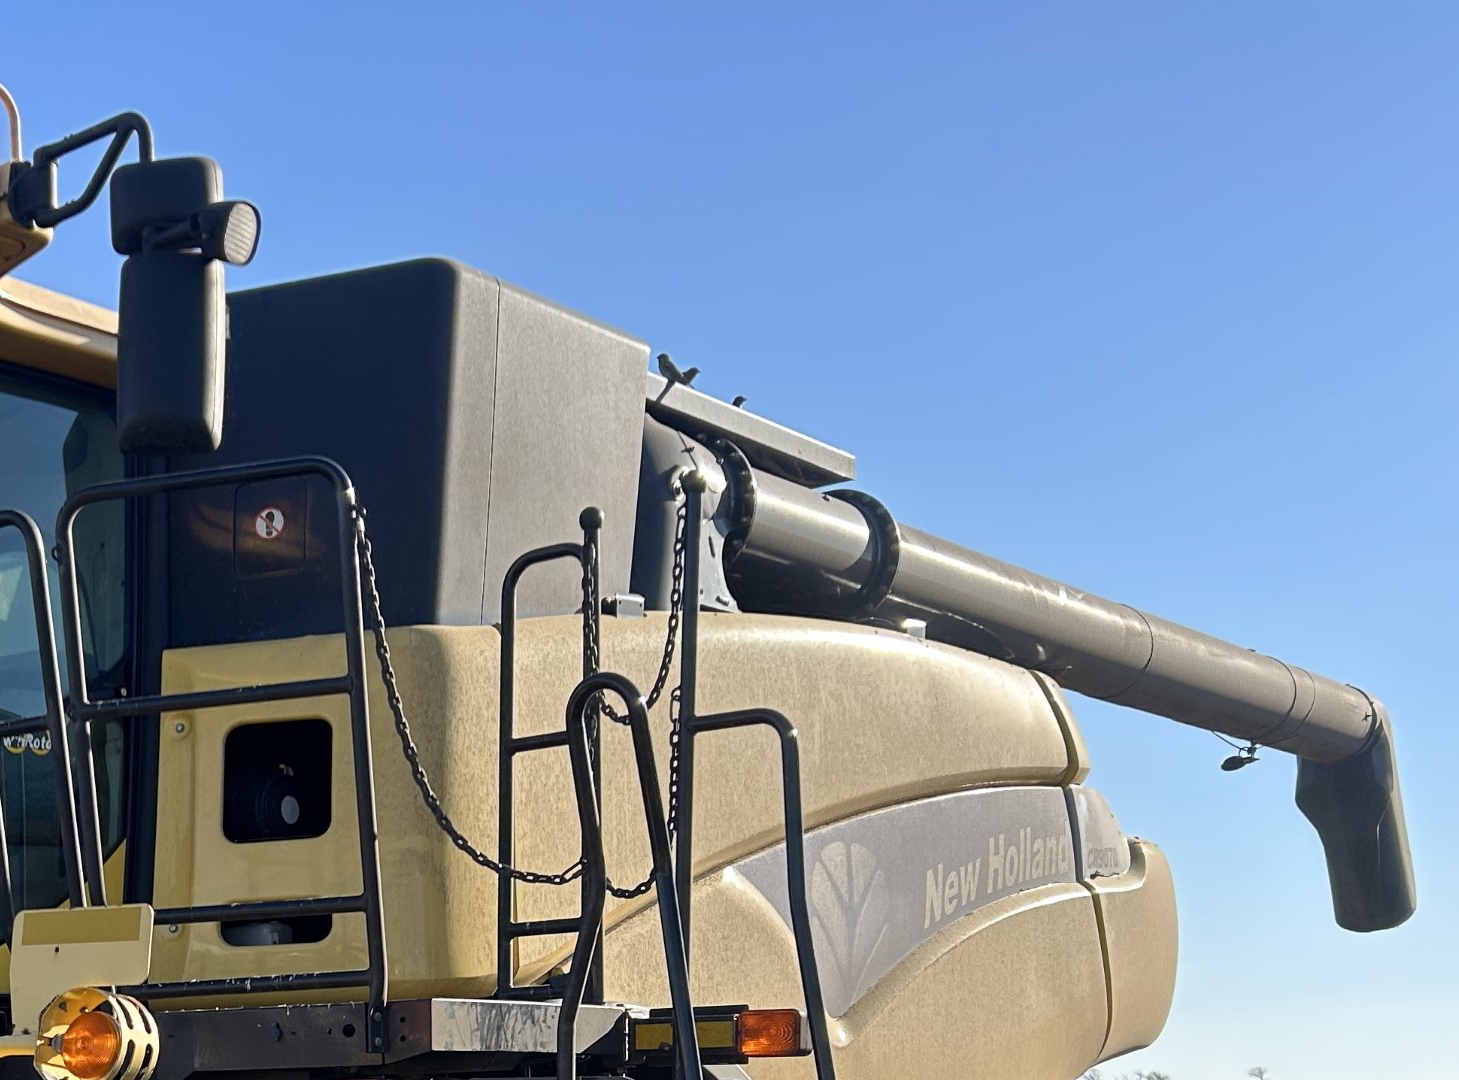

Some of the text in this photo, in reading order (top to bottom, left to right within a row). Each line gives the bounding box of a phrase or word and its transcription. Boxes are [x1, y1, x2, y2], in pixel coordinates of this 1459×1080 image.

[924, 820, 1070, 930] New Holland
[1087, 847, 1119, 869] CR9070
